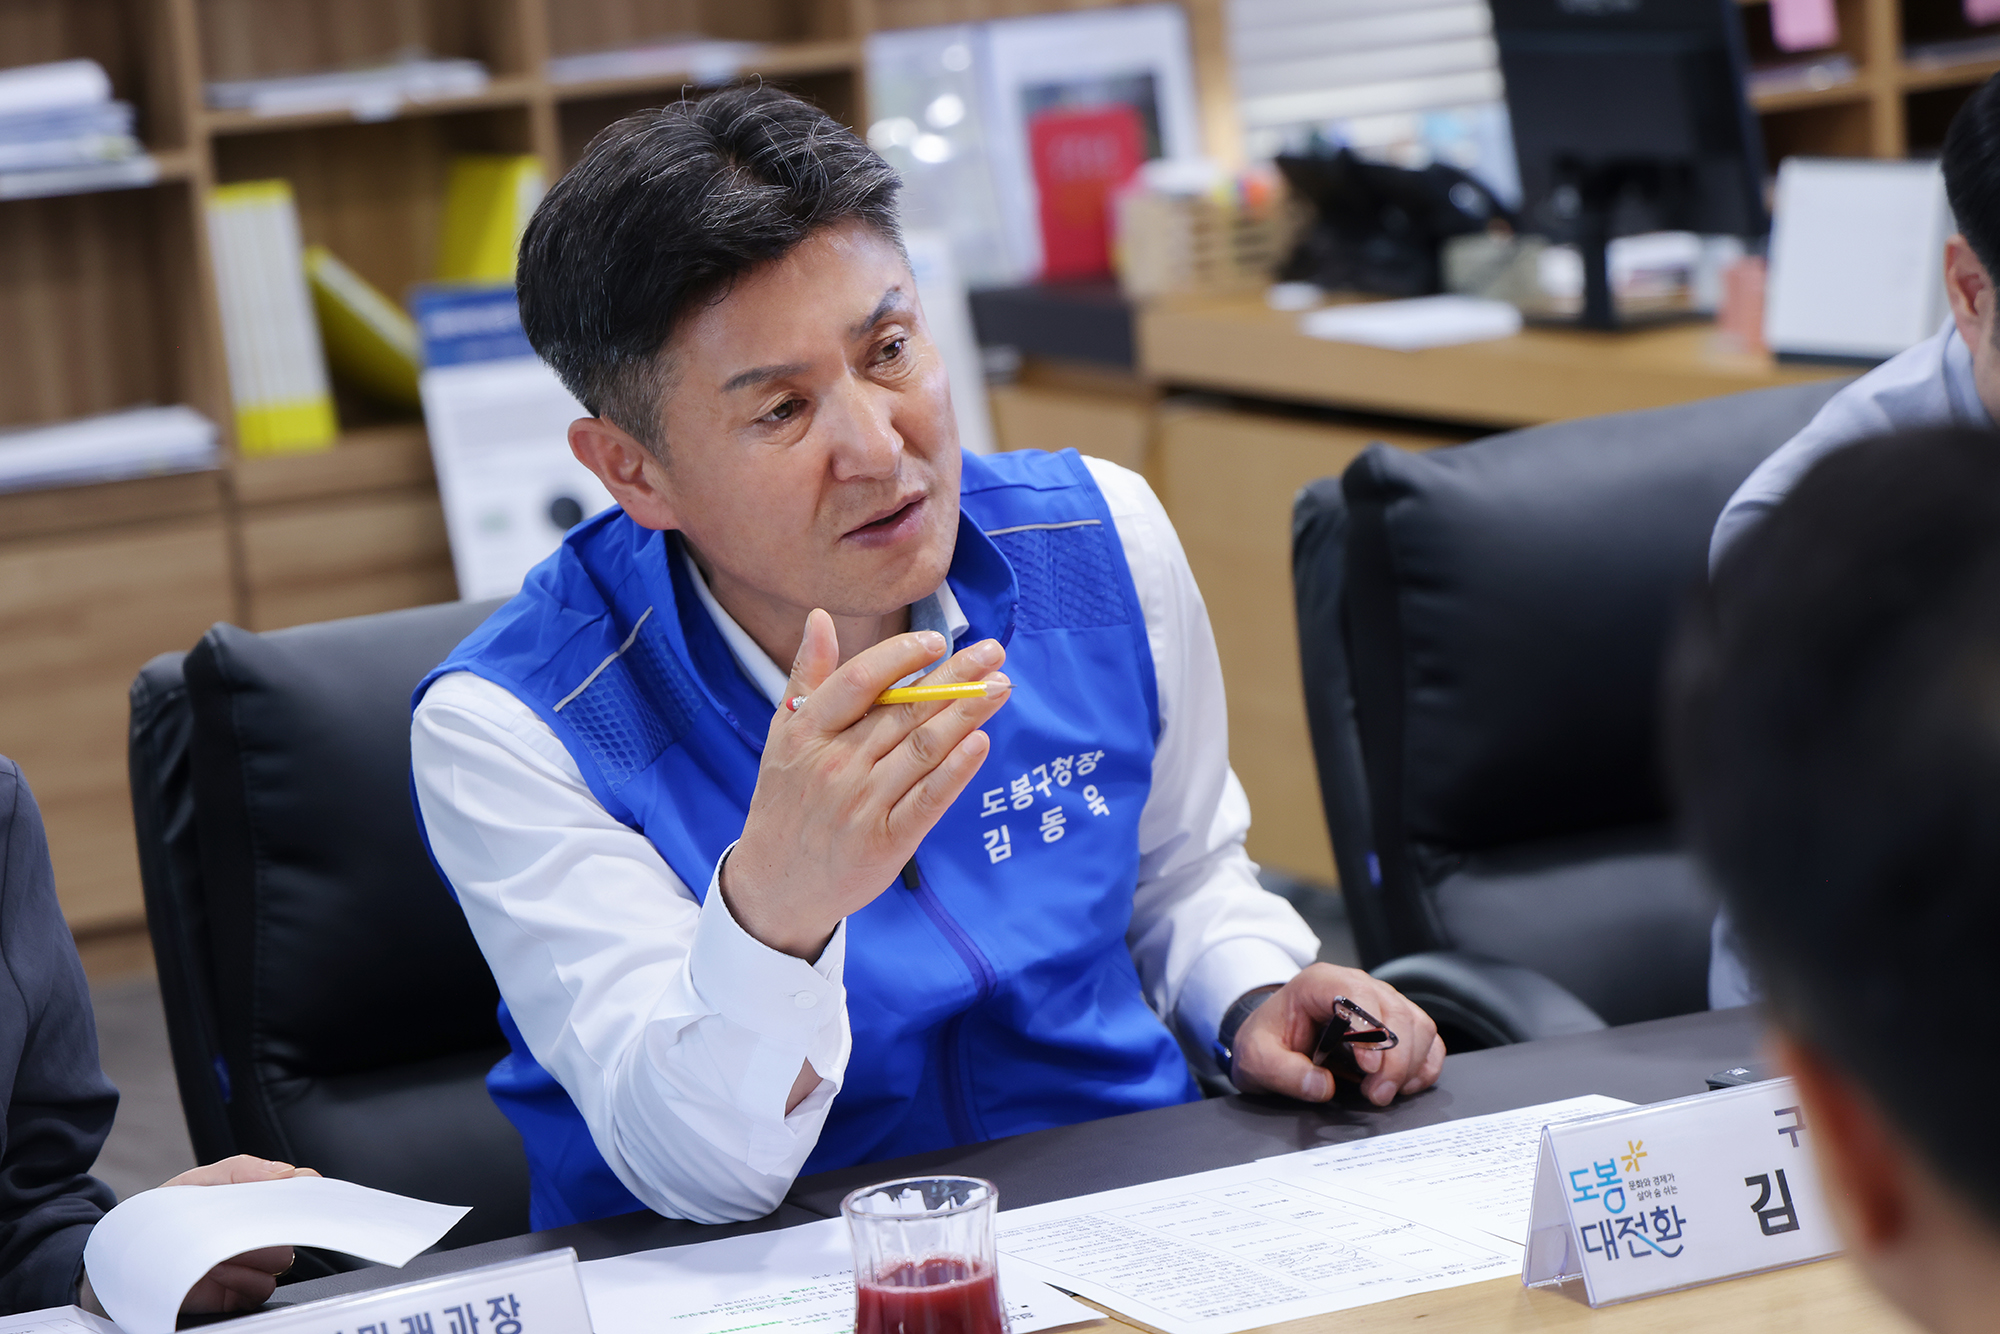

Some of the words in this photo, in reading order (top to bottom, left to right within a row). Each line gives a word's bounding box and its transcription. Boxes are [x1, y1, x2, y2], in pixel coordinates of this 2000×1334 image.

[980, 750, 1105, 818] 도봉구청장
[1773, 1105, 1807, 1148] 구
[1569, 1158, 1626, 1214] 도봉
[1628, 1178, 1651, 1191] 문화와
[1652, 1173, 1676, 1186] 경제가
[1637, 1190, 1653, 1201] 살아
[1654, 1188, 1662, 1198] 숨
[1663, 1185, 1679, 1195] 쉬는
[1744, 1168, 1801, 1236] 김
